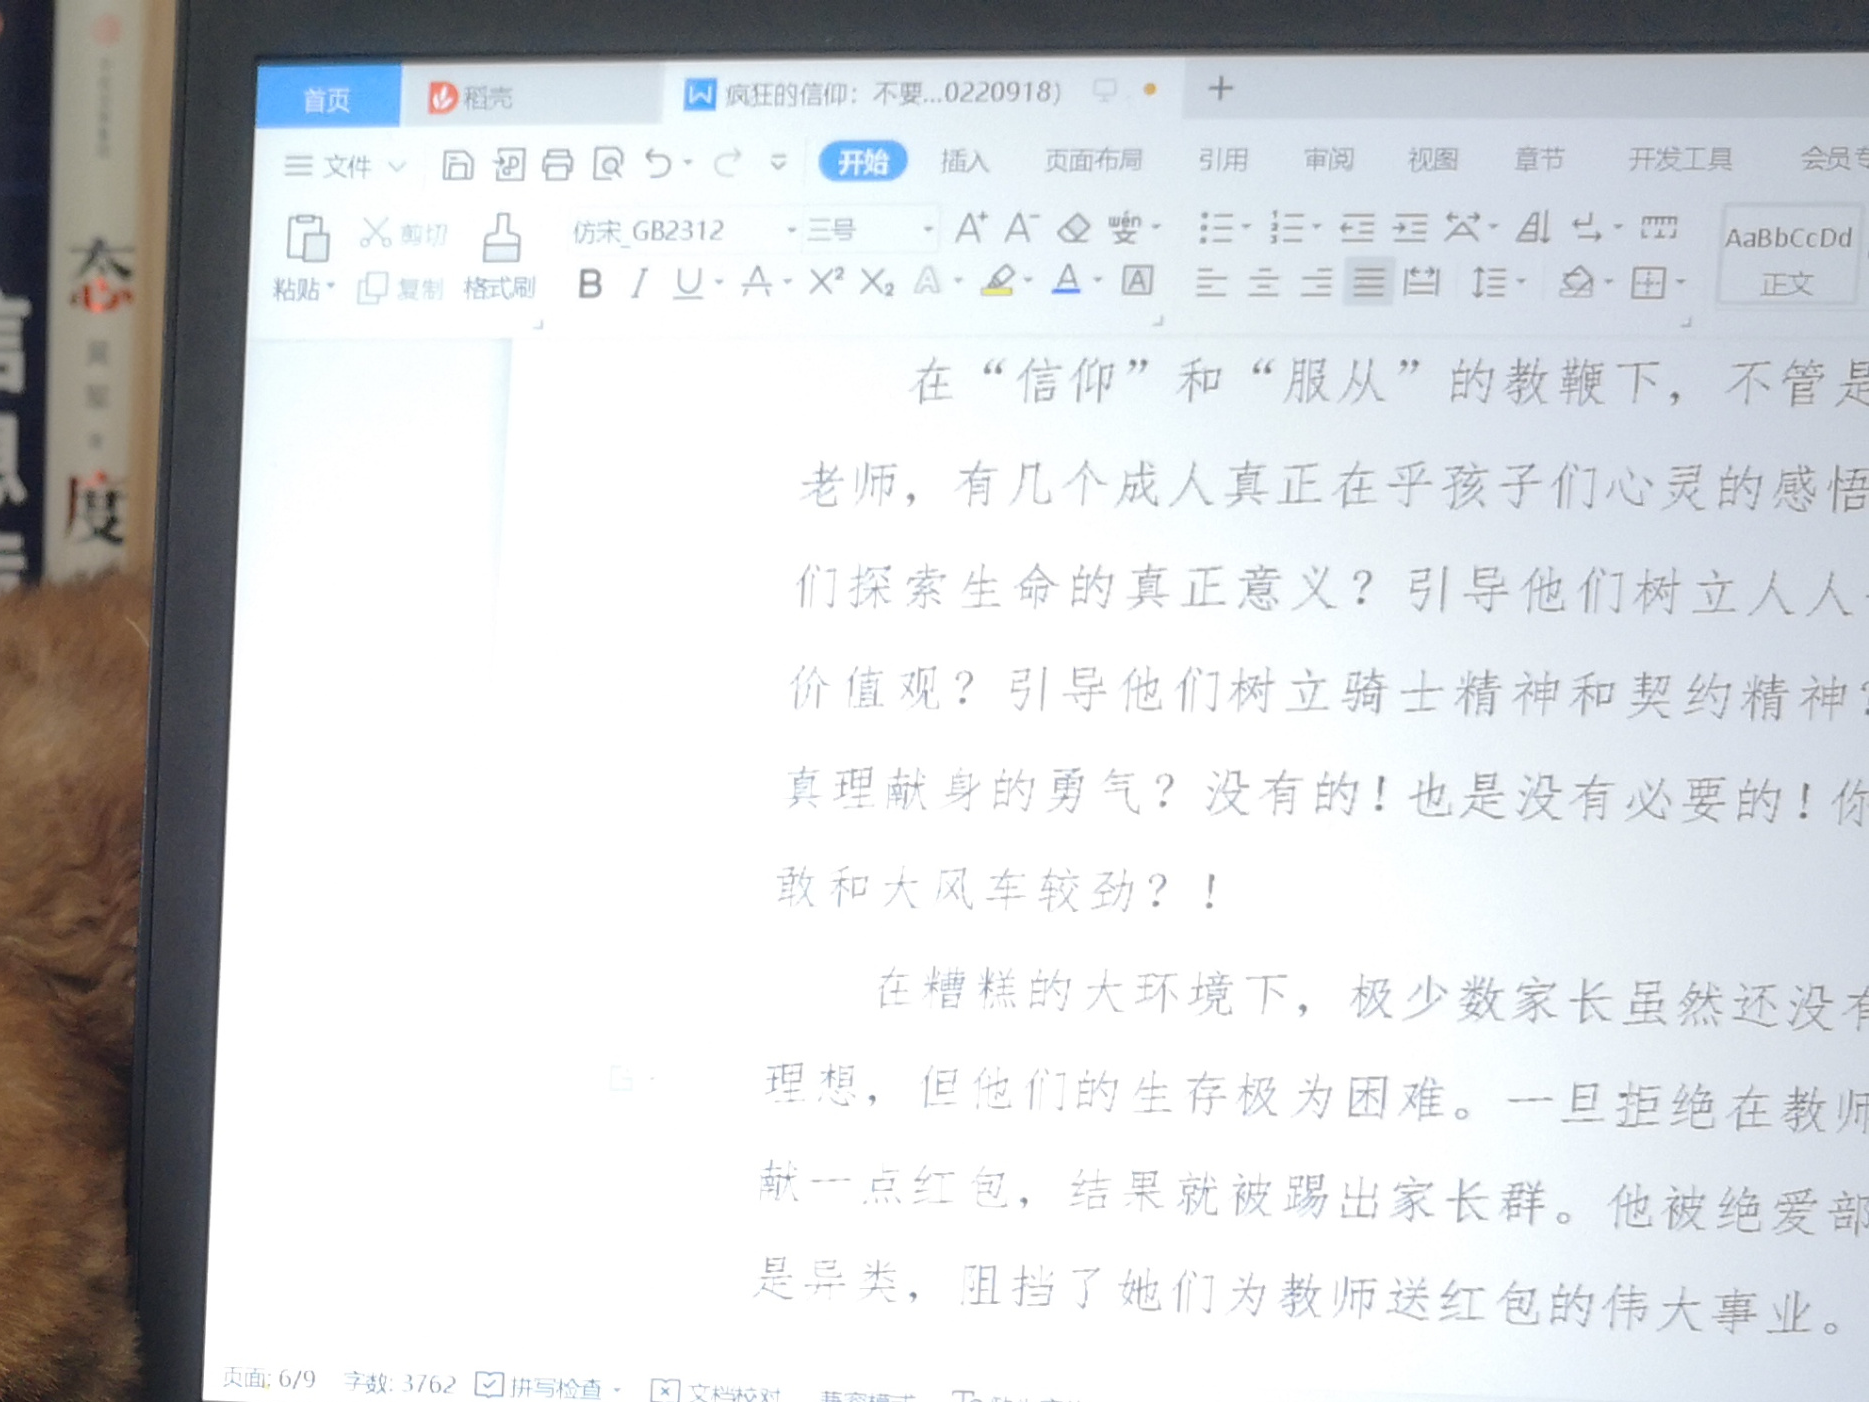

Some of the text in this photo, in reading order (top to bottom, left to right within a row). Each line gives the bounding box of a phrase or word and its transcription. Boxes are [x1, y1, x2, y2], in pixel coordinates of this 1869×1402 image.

[303, 87, 350, 114] 首页
[463, 85, 514, 110] 稻壳
[322, 153, 372, 179] 文件
[838, 149, 889, 176] 开始
[941, 147, 990, 174] 插入
[1044, 146, 1144, 174] 页面布局
[1198, 146, 1248, 172] 引用
[1303, 146, 1355, 173] 审阅
[1407, 146, 1460, 173] 视图
[1514, 146, 1565, 173] 章节
[1628, 146, 1733, 172] 开发工具
[400, 221, 447, 247] 剪切
[806, 218, 856, 242] 三号
[1724, 227, 1853, 248] AaBbCcDd
[272, 277, 322, 302] 粘贴
[397, 274, 445, 302] 复制
[463, 274, 536, 300] 格式刷
[1760, 270, 1815, 297] 正文
[796, 562, 1869, 617] 们探索生命的真正意义？引导他们树立人人
[402, 1375, 457, 1395] 3762
[511, 1376, 602, 1400] 拼写检查
